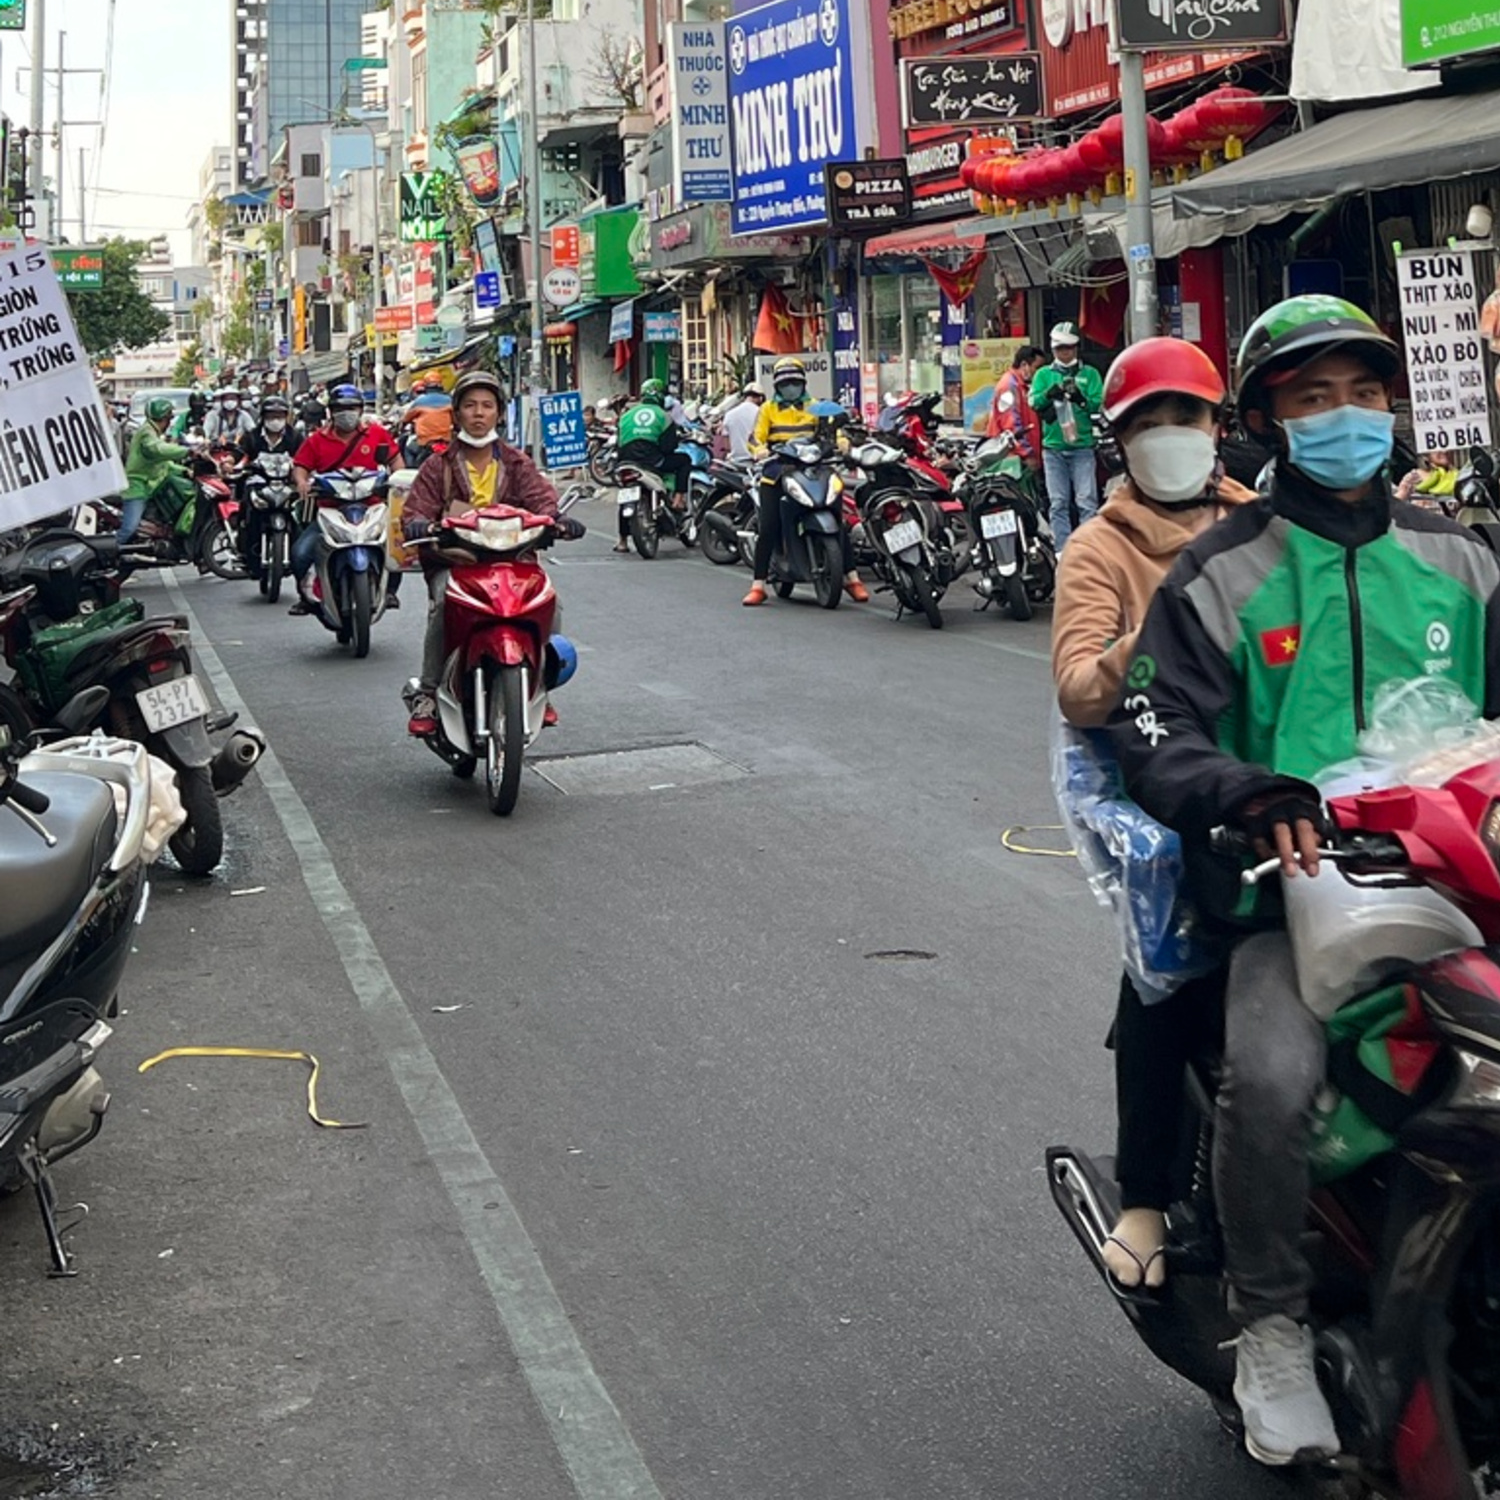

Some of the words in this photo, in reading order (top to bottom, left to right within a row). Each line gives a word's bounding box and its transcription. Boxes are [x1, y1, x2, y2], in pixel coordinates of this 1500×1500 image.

[683, 28, 716, 48] NHÀ
[678, 50, 724, 72] THUỐC
[680, 104, 727, 126] MINH
[733, 80, 791, 177] MINH
[793, 47, 843, 162] THƯ
[686, 134, 724, 159] THƯ
[855, 178, 903, 194] PIZZA
[846, 205, 871, 219] TRÀ
[1409, 252, 1463, 280] BÚN
[1403, 284, 1437, 306] THỊT
[1443, 279, 1473, 301] XÀO
[1406, 315, 1436, 336] NUI
[1455, 306, 1477, 332] MÌ
[9, 342, 77, 381] TRỨNG
[1411, 340, 1447, 366] XÀO
[1453, 337, 1478, 362] BÒ
[44, 396, 112, 475] GIÒN
[1424, 426, 1449, 450] BÒ
[1455, 424, 1483, 447] BÍA
[153, 698, 200, 727] 2324
